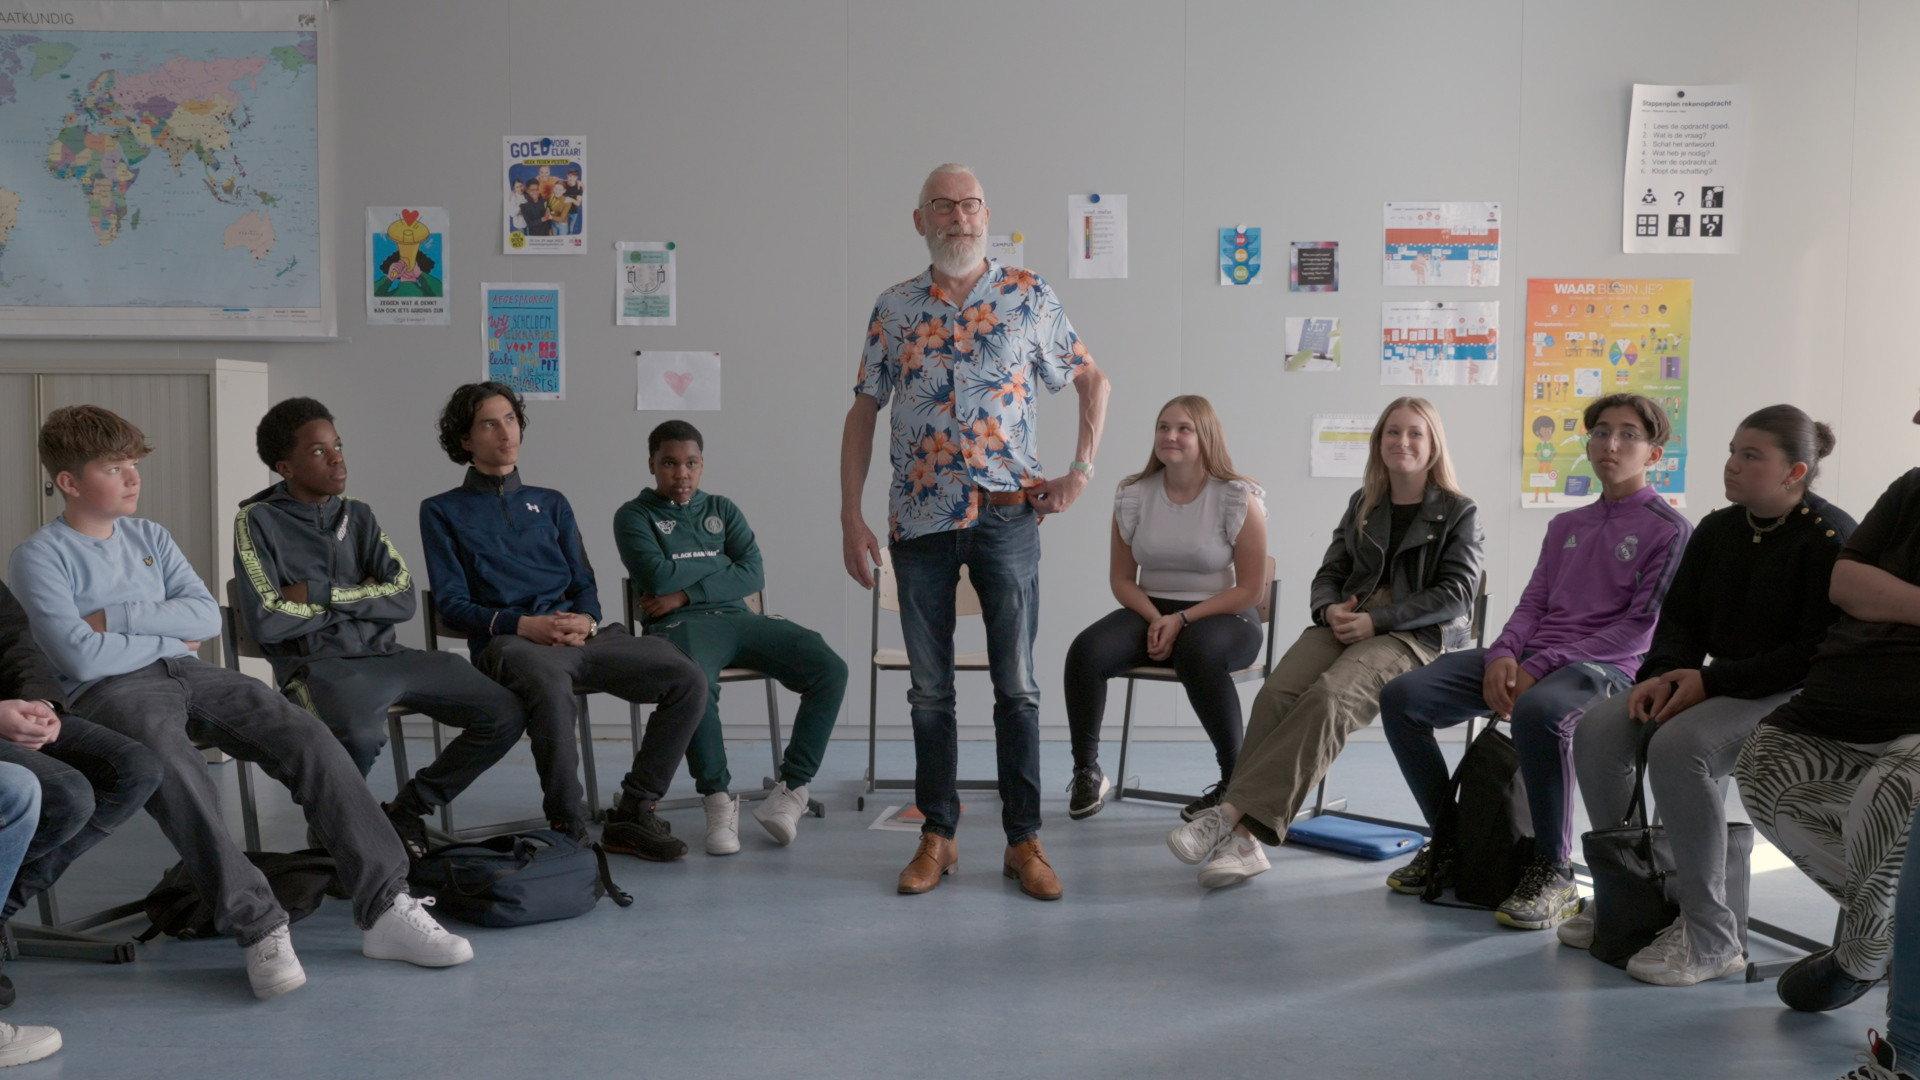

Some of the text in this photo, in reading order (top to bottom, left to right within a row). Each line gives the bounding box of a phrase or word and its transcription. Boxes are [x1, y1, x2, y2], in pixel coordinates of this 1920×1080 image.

[1642, 100, 1681, 108] Stappenplan
[1680, 123, 1709, 131] opdracht
[511, 140, 550, 158] GOED
[1688, 150, 1710, 158] nodig?
[1679, 168, 1713, 176] schatting?
[1554, 283, 1596, 295] WAAR
[672, 551, 693, 560] BLACK
